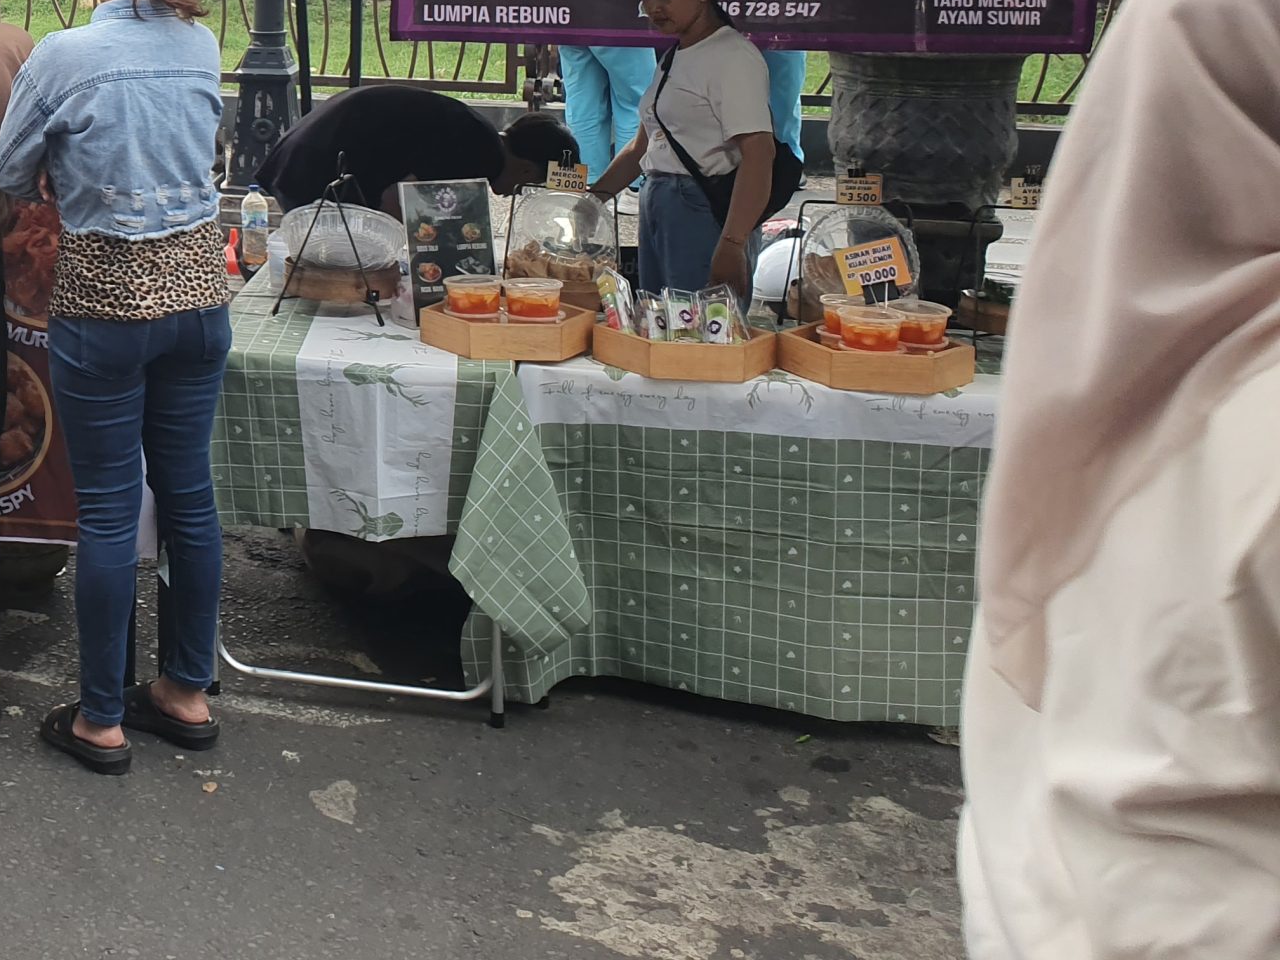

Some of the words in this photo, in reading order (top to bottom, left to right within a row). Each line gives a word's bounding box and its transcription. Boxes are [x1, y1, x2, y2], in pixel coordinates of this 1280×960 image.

[423, 4, 490, 23] LUMPIA
[495, 5, 570, 24] REBUNG
[745, 2, 780, 17] 728
[784, 2, 821, 17] 547
[937, 10, 983, 25] AYAM
[987, 10, 1041, 26] SUWIR
[552, 171, 582, 179] MERCON
[556, 179, 584, 190] 3.000
[1022, 196, 1038, 205] 3.5
[845, 250, 870, 260] ASINAN
[872, 244, 891, 254] BUAH
[848, 260, 868, 269] KUAH
[870, 254, 893, 264] LEMON
[860, 266, 896, 284] 10.000
[6, 321, 48, 349] MUR
